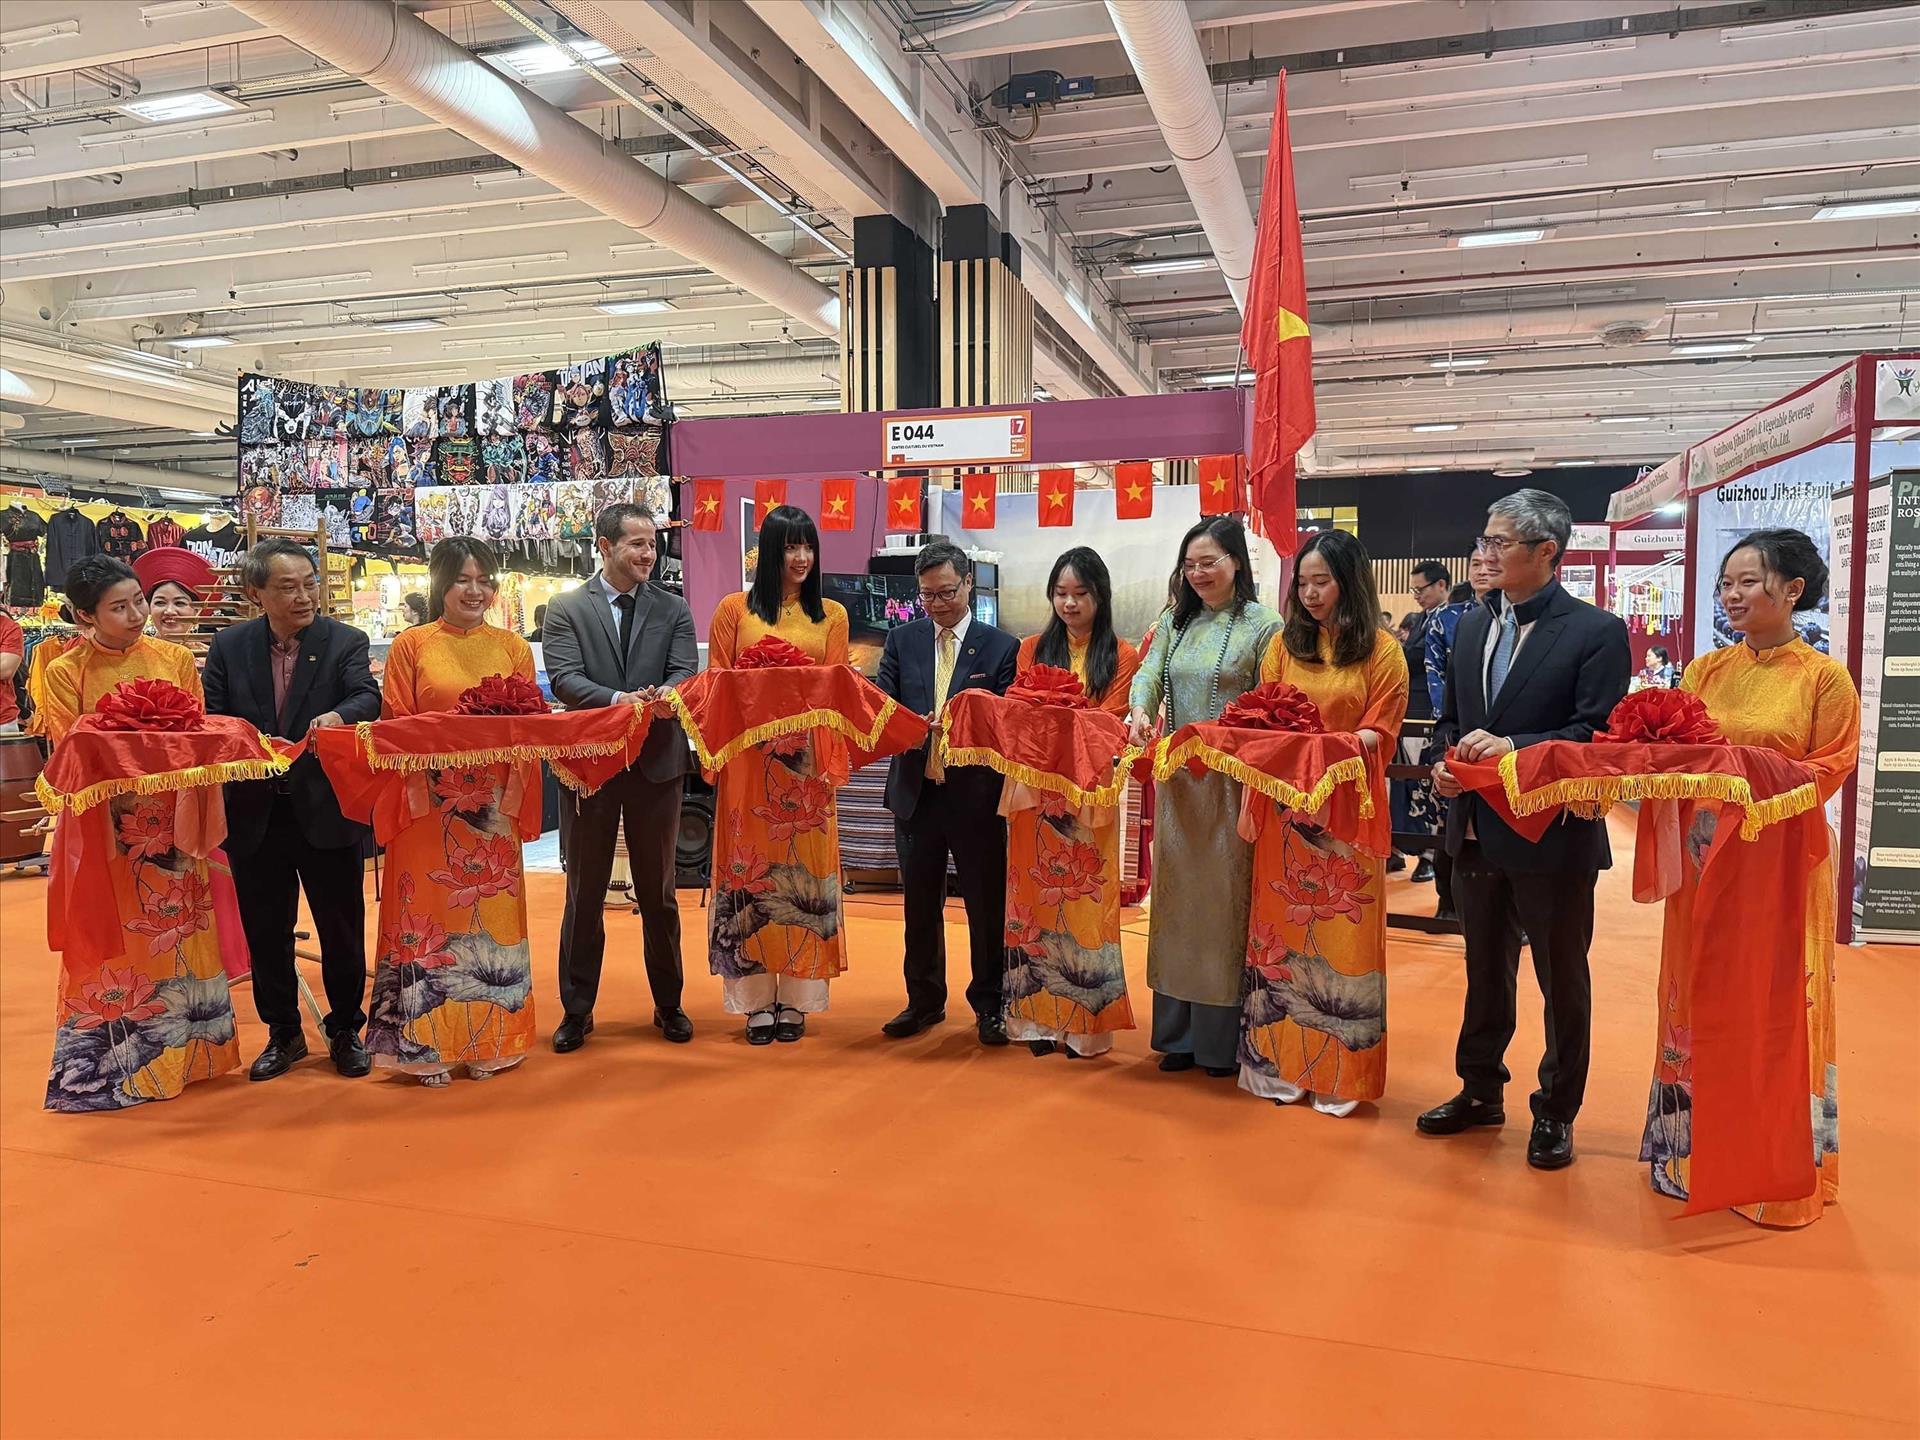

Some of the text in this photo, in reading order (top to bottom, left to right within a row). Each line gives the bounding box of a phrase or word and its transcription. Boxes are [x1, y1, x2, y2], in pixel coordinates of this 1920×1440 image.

[892, 424, 935, 441] E 044
[1015, 420, 1025, 433] 7
[1713, 440, 1734, 458] Guizhou
[1762, 412, 1788, 435] Vegetable
[1788, 402, 1815, 424] Beverage
[1715, 452, 1743, 475] Engineering
[1717, 484, 1768, 505] Guizhou
[1770, 481, 1801, 501] Jihai
[1897, 496, 1920, 506] INT
[1870, 519, 1886, 533] GLOBE
[1634, 534, 1674, 544] Guizhou
